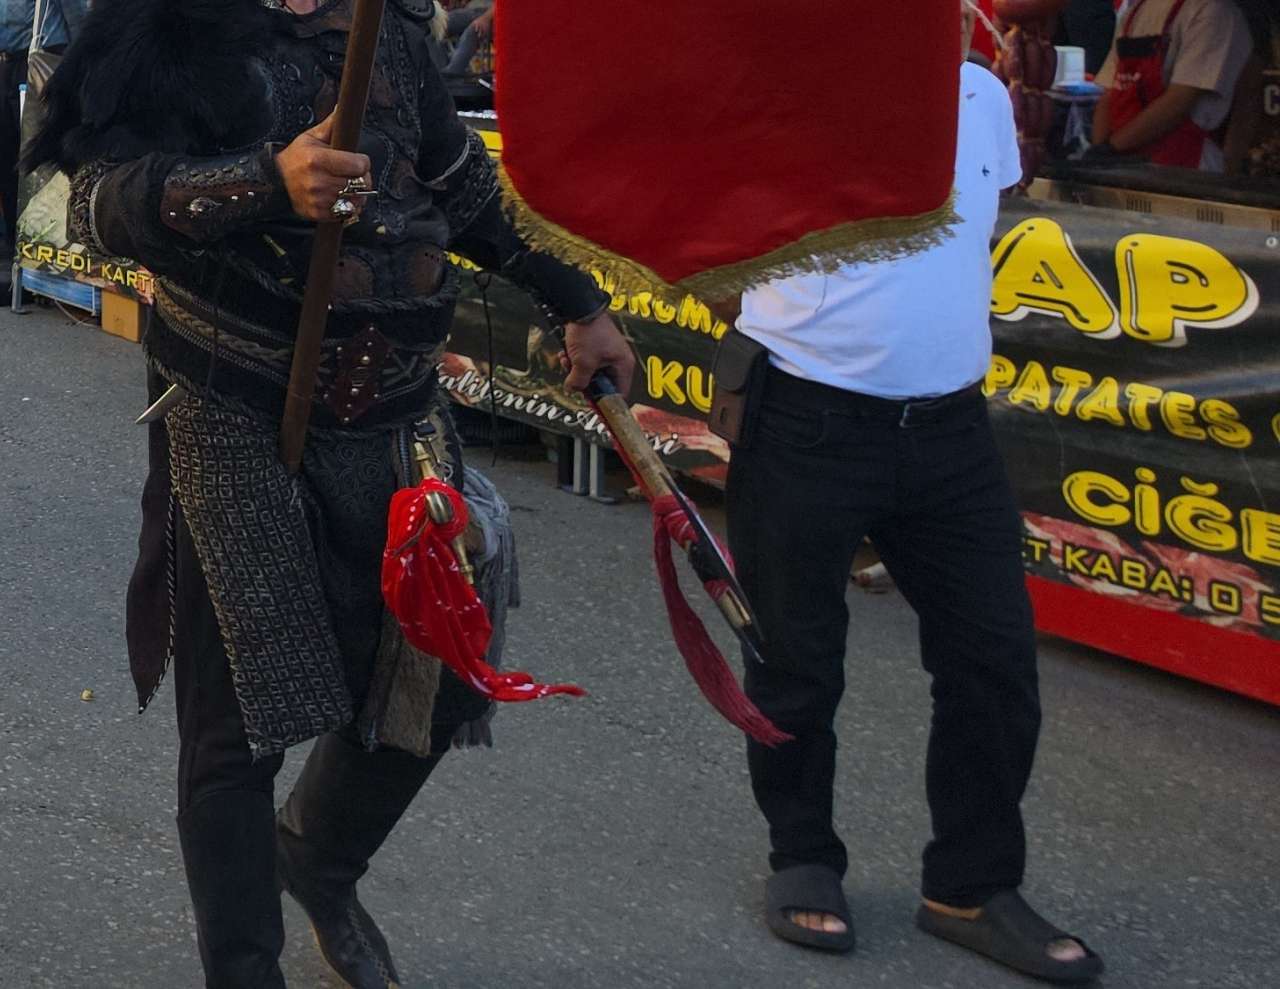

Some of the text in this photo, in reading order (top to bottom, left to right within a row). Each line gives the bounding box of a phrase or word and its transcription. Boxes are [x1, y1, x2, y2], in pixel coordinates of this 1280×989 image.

[19, 242, 91, 274] KREDİ
[992, 217, 1260, 348] AP
[436, 361, 567, 422] alitenin
[646, 355, 715, 414] KU
[981, 354, 1253, 449] PATATES
[1064, 544, 1193, 603] KABA:
